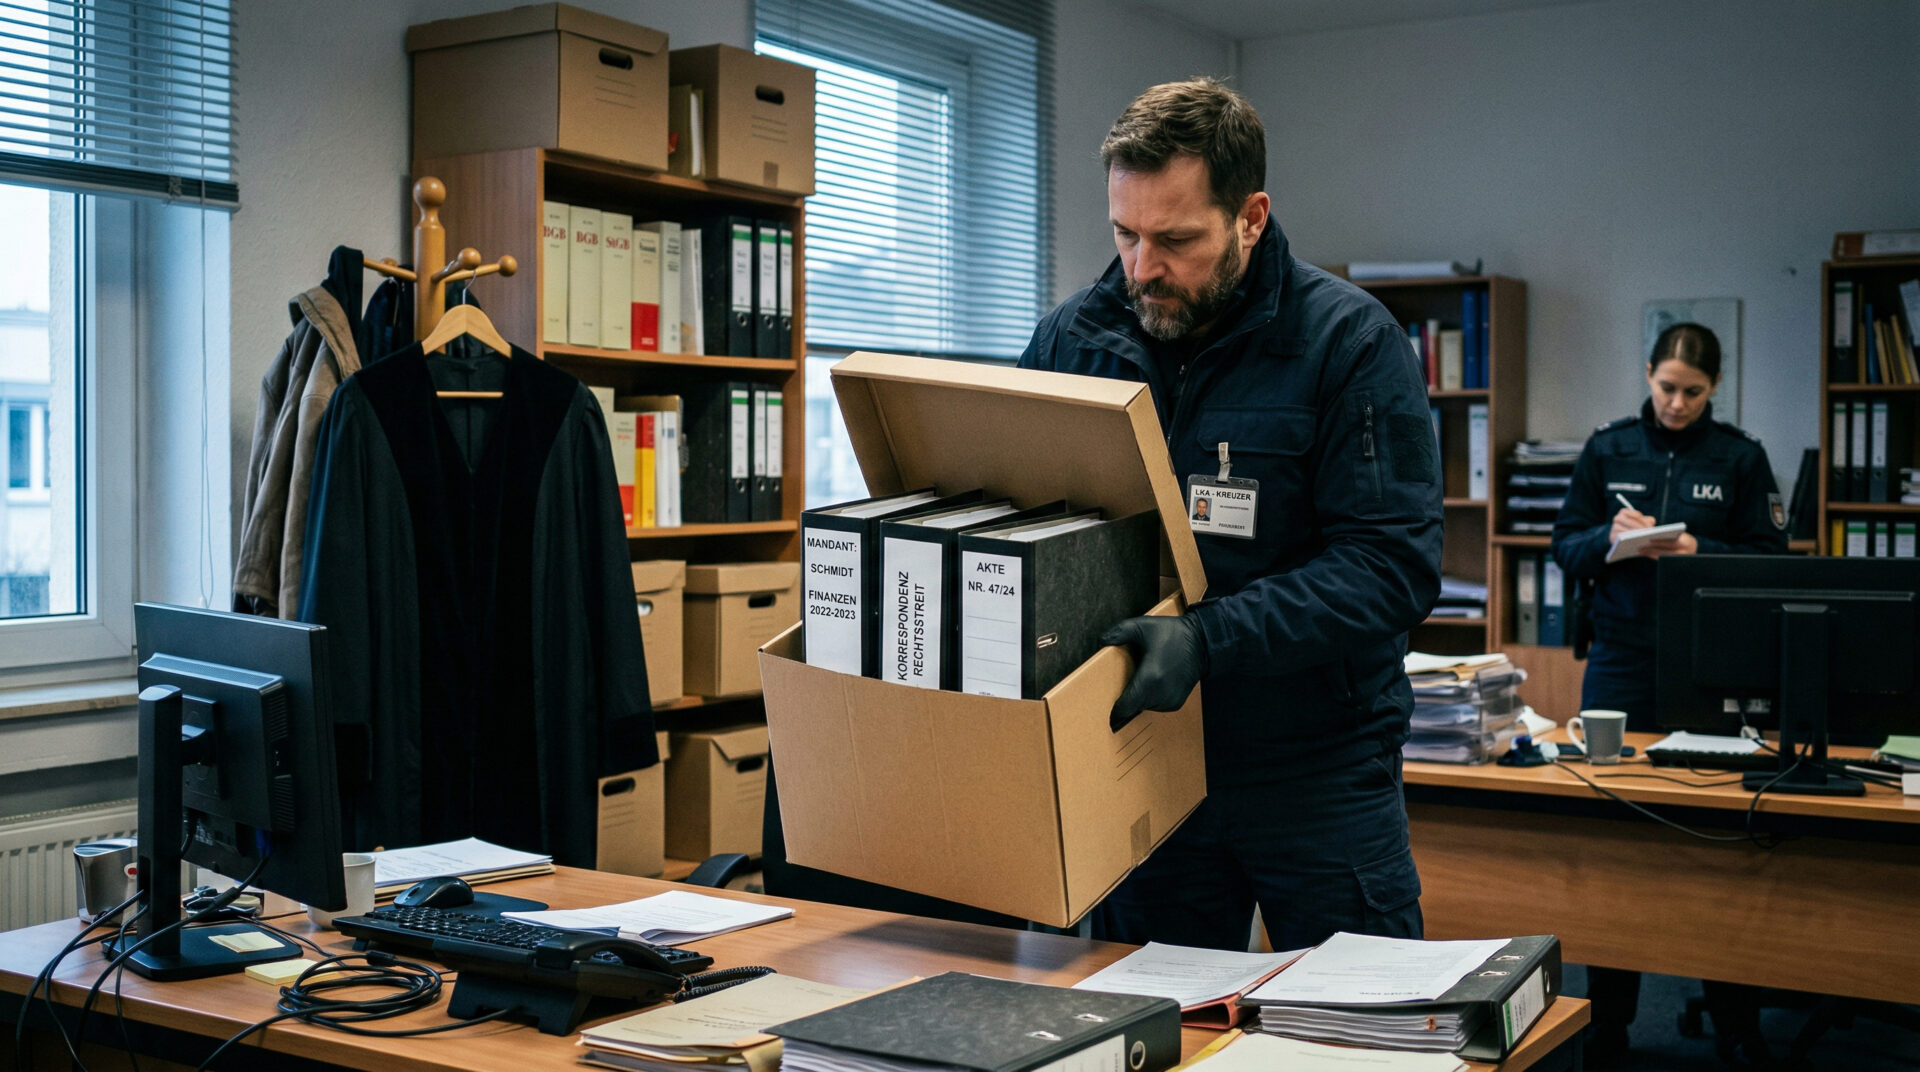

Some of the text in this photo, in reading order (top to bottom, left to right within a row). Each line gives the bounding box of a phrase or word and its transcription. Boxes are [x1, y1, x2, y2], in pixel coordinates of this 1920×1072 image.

[543, 225, 566, 240] BGB
[576, 231, 599, 245] BGB
[605, 236, 630, 250] StGB
[1195, 488, 1210, 496] LKA
[1216, 490, 1251, 501] KREUZER
[1692, 484, 1723, 501] LKA
[807, 537, 857, 552] MANDANT:
[810, 563, 854, 578] SCHMIDT
[976, 562, 1005, 575] AKTE
[968, 581, 1015, 596] NR. 47/24
[808, 590, 857, 605] FINANZEN
[810, 605, 856, 620] 2022-2023
[897, 570, 909, 681] KORRESPONDENZ
[913, 583, 925, 677] RECHTSSTREIT
